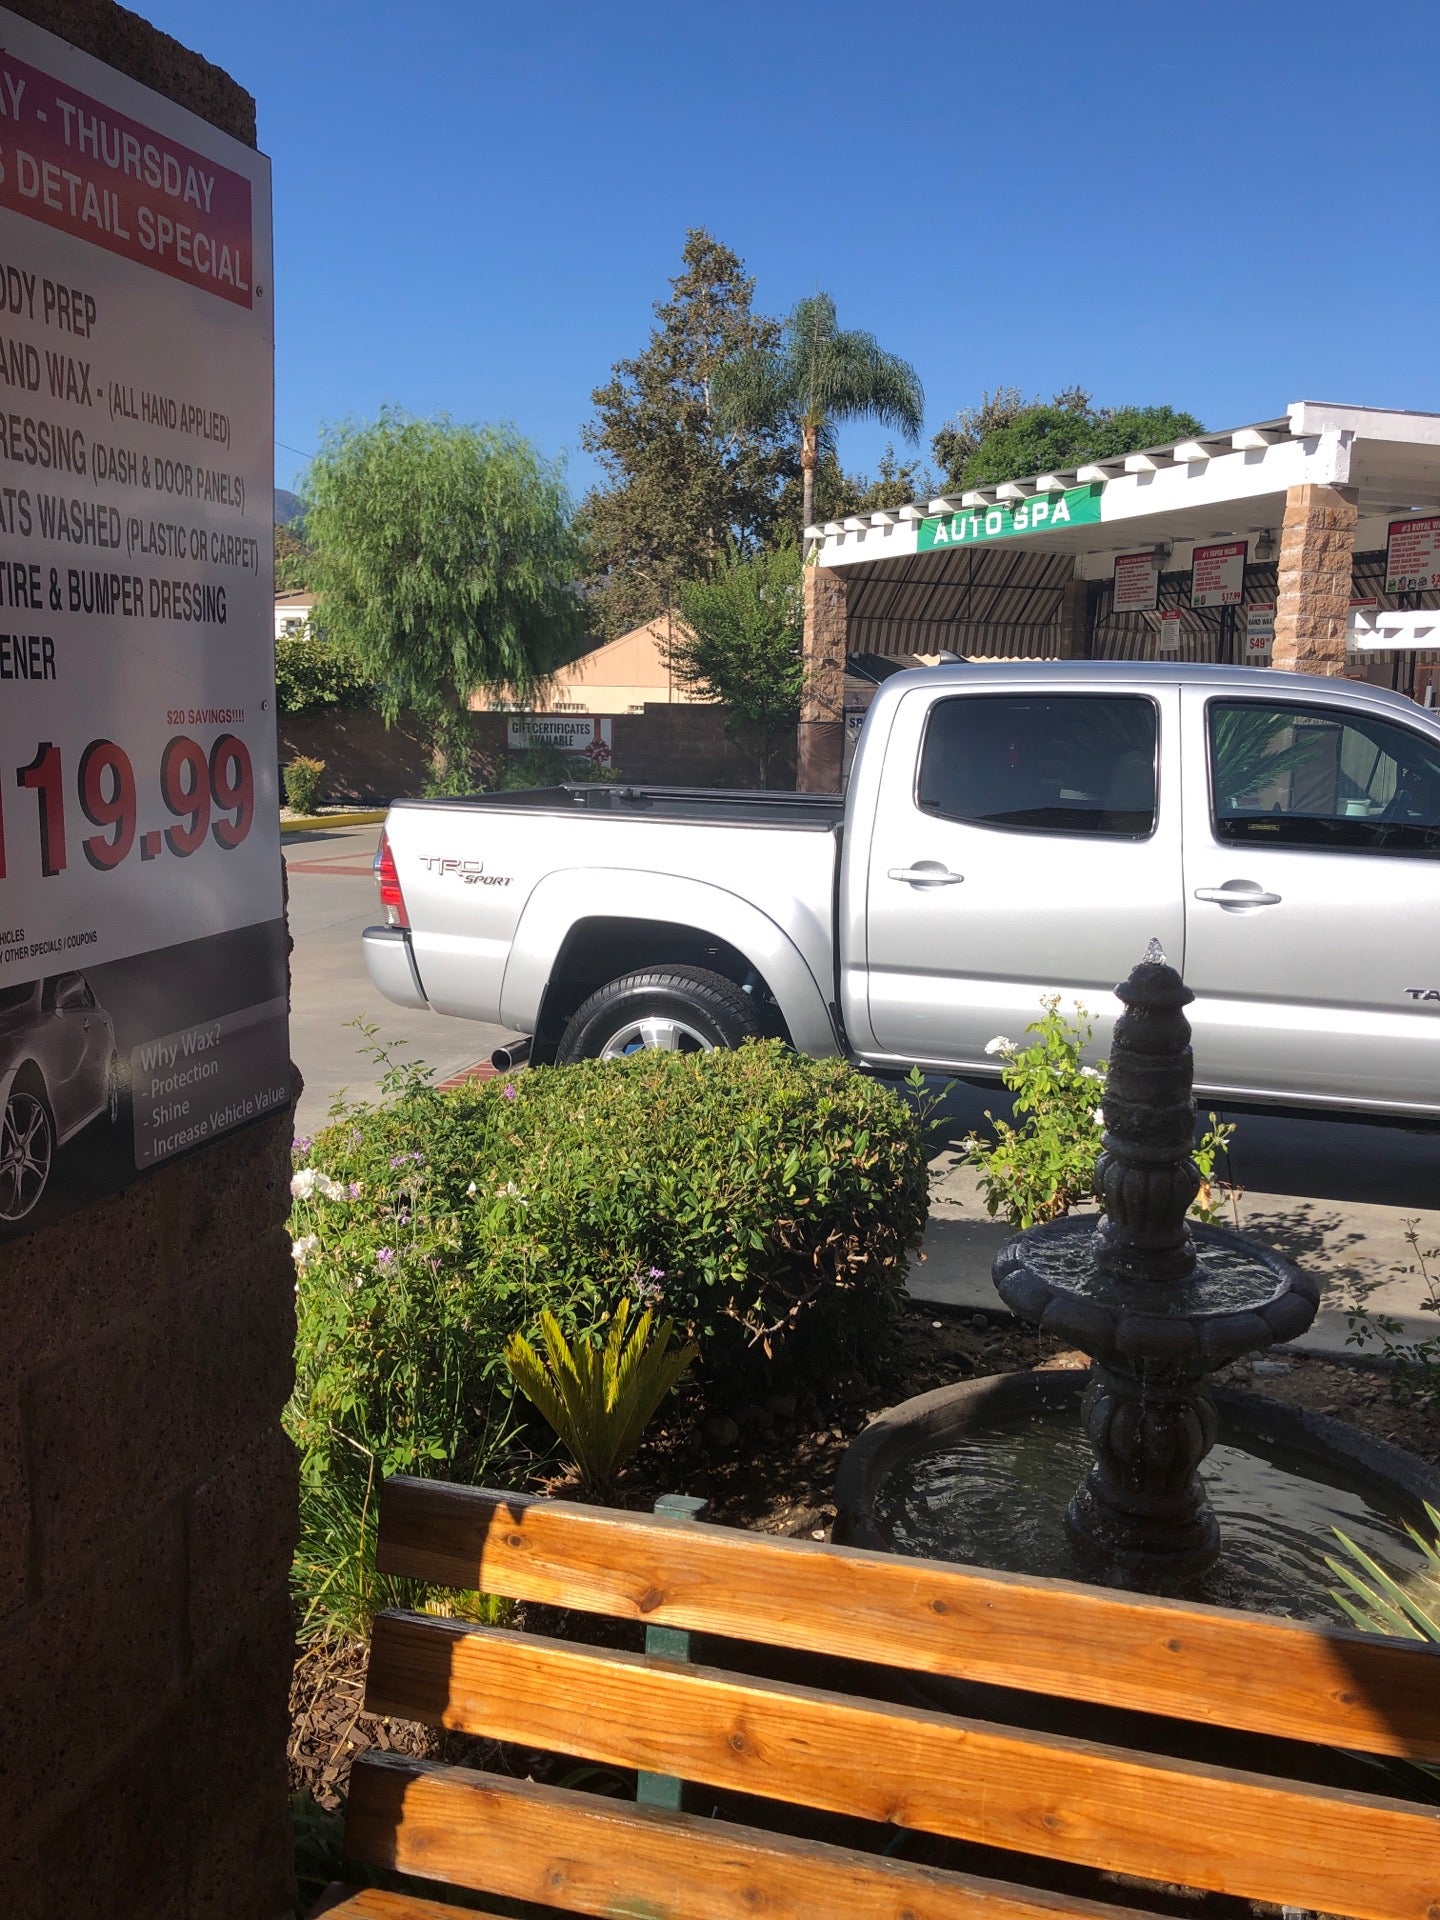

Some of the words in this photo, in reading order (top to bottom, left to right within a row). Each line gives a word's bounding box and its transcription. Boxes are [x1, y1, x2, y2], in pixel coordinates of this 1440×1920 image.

[56, 97, 215, 213] THURSDAY
[16, 149, 130, 241] DETAIL
[137, 206, 249, 291] SPECIAL
[43, 278, 97, 338] PREP
[108, 381, 139, 421] (ALL
[141, 391, 177, 430] HAND
[180, 403, 231, 452] APPLIED)
[92, 442, 138, 487] (DASH
[142, 455, 151, 489] &
[155, 458, 193, 497] DOOR
[197, 467, 245, 516] PANELS)
[36, 493, 121, 549] WASHED
[126, 517, 186, 560] (PLASTIC
[190, 528, 207, 561] OR
[211, 532, 259, 576] CARPET)
[933, 511, 1002, 544] AUTO
[1013, 498, 1071, 530] SPA
[1411, 522, 1431, 531] ROYAL
[50, 567, 63, 611] &
[67, 569, 145, 617] BUMPER
[149, 577, 227, 624] DRESSING
[1221, 591, 1241, 602] $17.99
[529, 734, 574, 747] VAILABLE
[533, 723, 590, 735] CERTIFICATES
[419, 855, 484, 877] TRD
[463, 874, 512, 887] SPORT
[4, 945, 29, 963] OTHER
[30, 937, 62, 957] SPECIALS
[67, 930, 98, 949] COUPONS
[141, 1042, 178, 1072] Why
[181, 1023, 221, 1058] Wax?
[151, 1060, 219, 1099] Protection
[152, 1100, 190, 1128] Shine
[153, 1120, 208, 1158] Increase
[209, 1099, 253, 1131] Vehicle
[254, 1086, 286, 1111] Value
